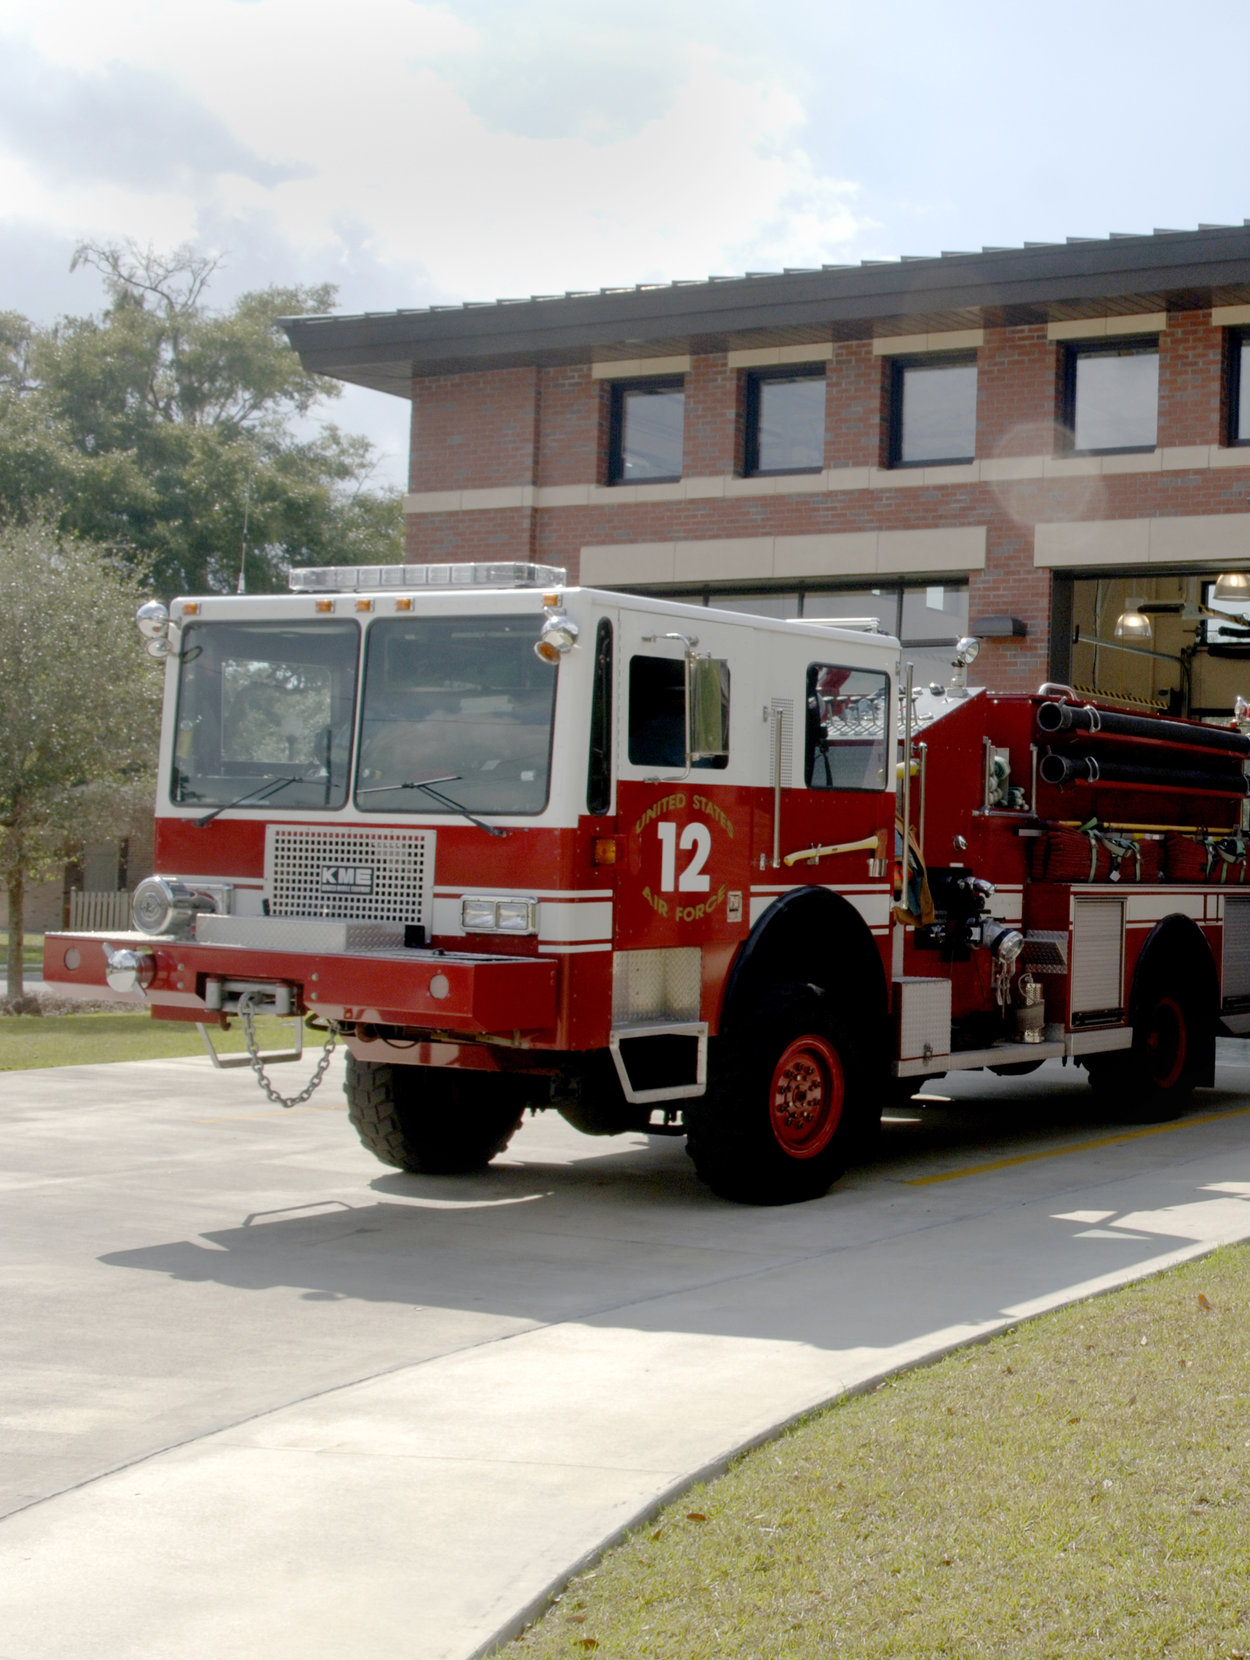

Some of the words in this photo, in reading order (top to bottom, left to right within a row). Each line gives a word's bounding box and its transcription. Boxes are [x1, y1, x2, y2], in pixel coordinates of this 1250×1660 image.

[635, 793, 686, 834] UNITED
[693, 795, 734, 838] STATES
[322, 867, 372, 885] KME
[657, 822, 711, 892] 12
[642, 886, 668, 917] AIR
[675, 884, 726, 922] FORCE
